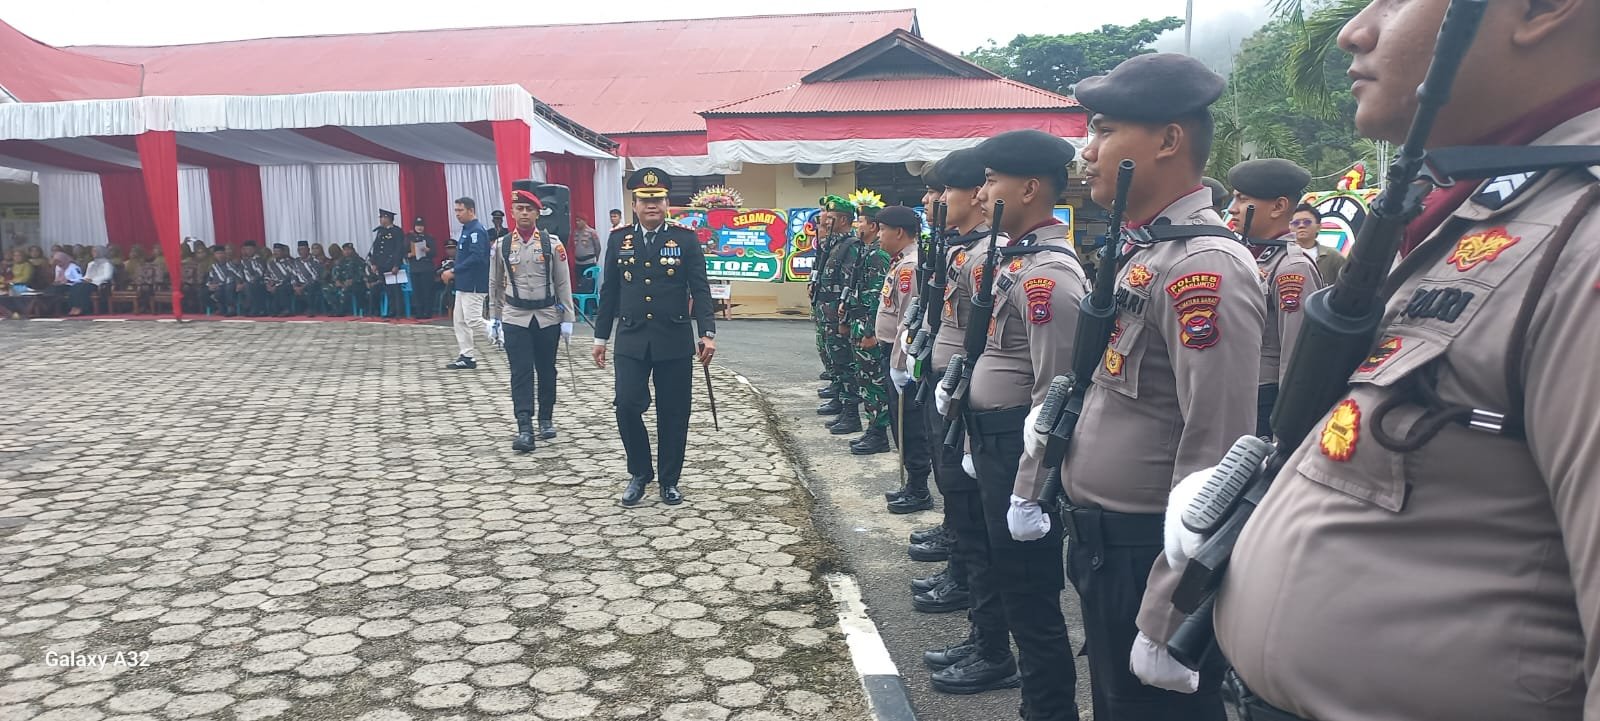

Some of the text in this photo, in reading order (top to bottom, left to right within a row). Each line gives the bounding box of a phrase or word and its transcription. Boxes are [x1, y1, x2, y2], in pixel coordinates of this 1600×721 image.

[733, 213, 776, 226] SELAMAT
[706, 260, 770, 272] TOFA
[1170, 275, 1217, 292] POLRES
